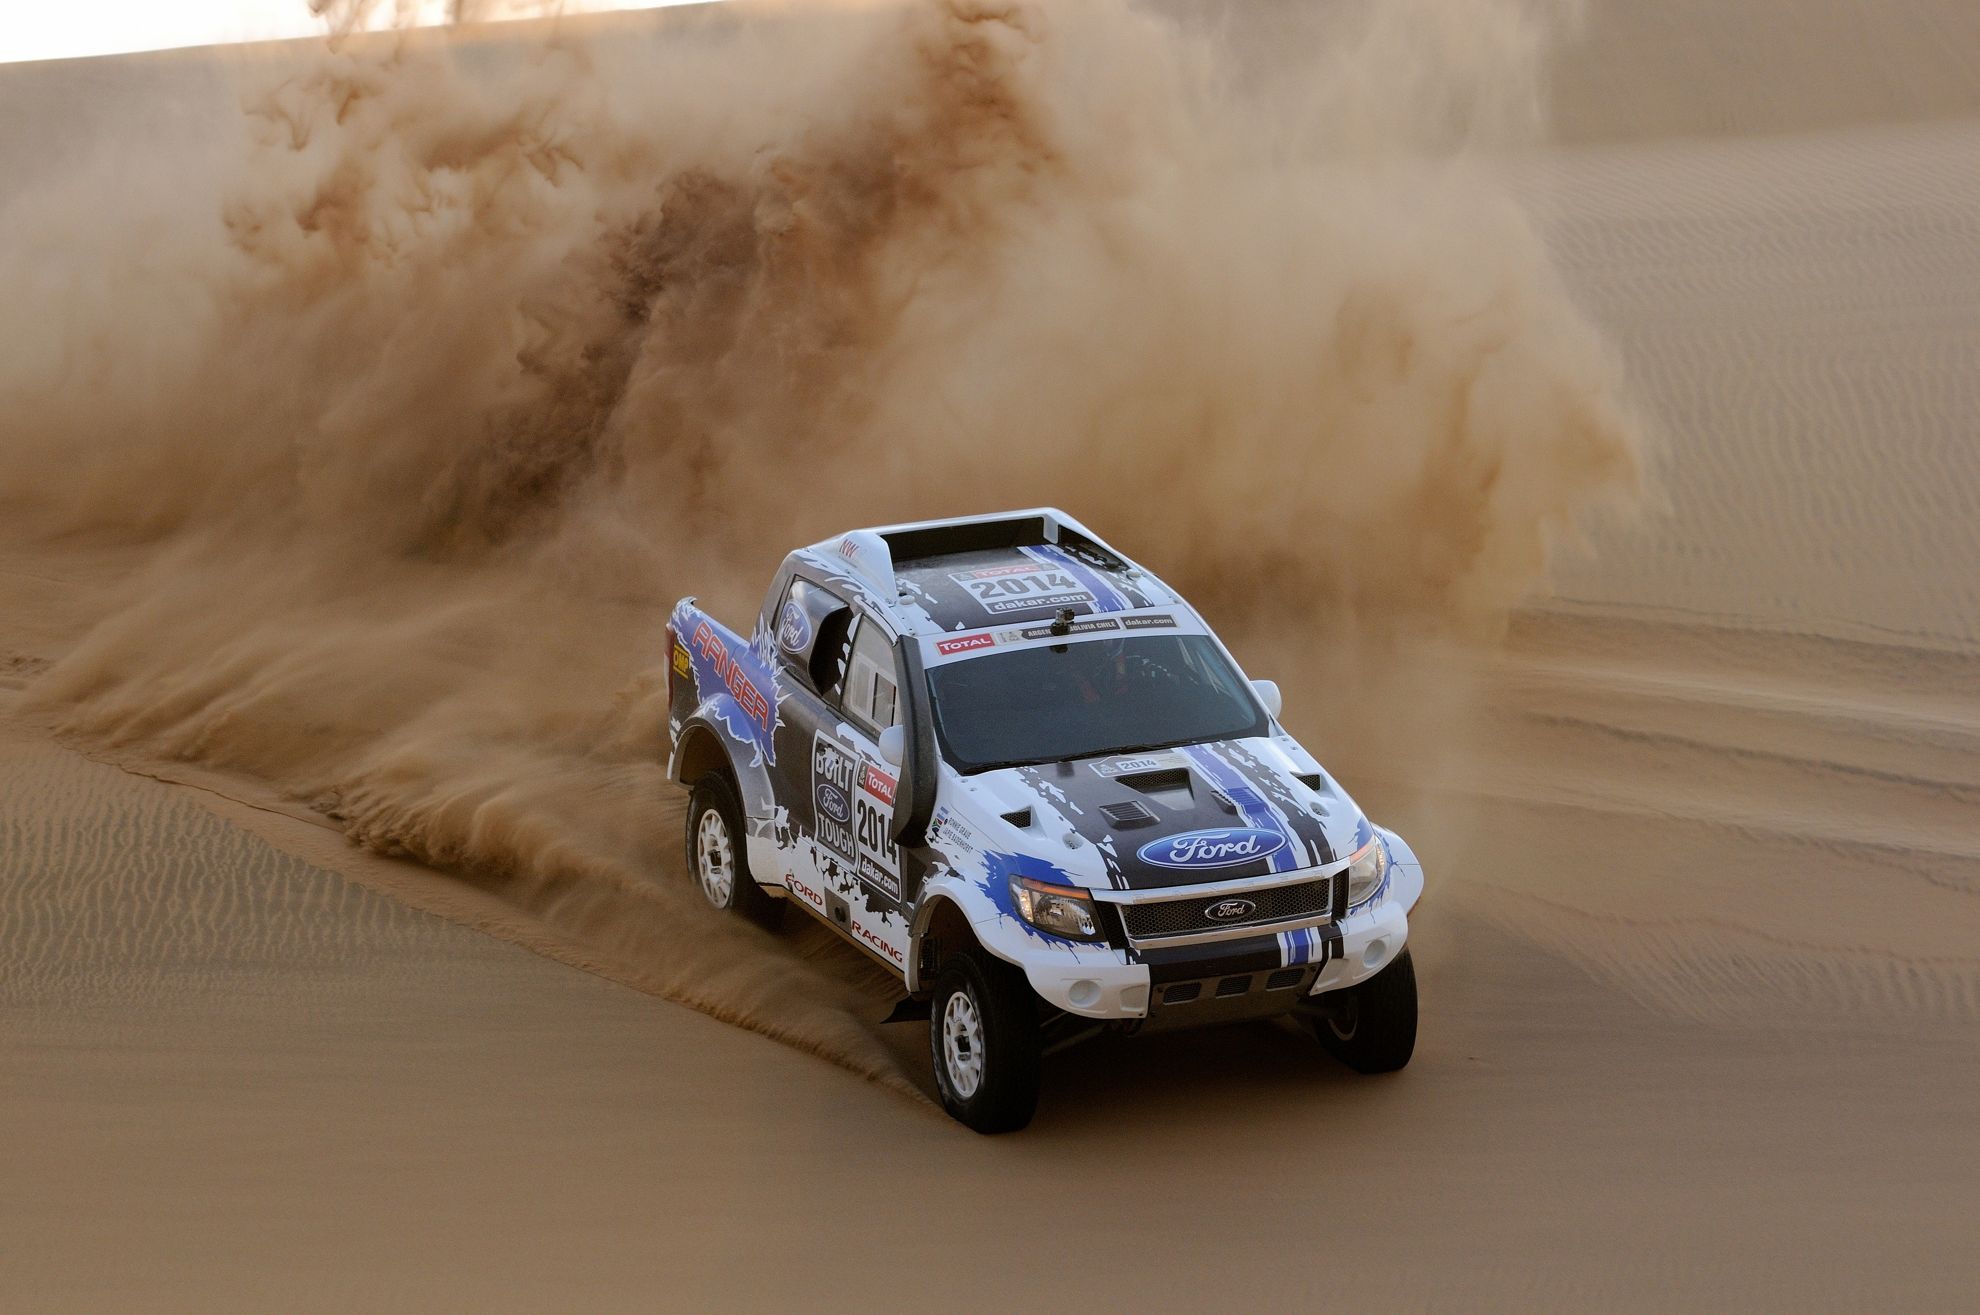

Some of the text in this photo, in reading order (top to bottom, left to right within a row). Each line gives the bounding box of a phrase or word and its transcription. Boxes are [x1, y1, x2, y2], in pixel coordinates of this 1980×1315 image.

[970, 573, 1077, 599] 2014
[994, 594, 1088, 611] dakar.com
[782, 606, 804, 647] Ford
[1027, 628, 1052, 637] ARGEN
[1095, 620, 1117, 629] CHILE
[1125, 618, 1174, 626] dakar.com
[939, 638, 991, 651] TOTAL
[692, 620, 769, 732] RANGER
[1121, 759, 1157, 770] 2014
[868, 772, 893, 799] TOTAL
[823, 788, 844, 819] Ford
[818, 812, 855, 858] TOUGH
[858, 798, 897, 865] 2014
[1169, 832, 1261, 863] Ford
[861, 858, 899, 895] dakar.com
[785, 873, 904, 964] FORD RACING
[1217, 902, 1245, 917] Ford
